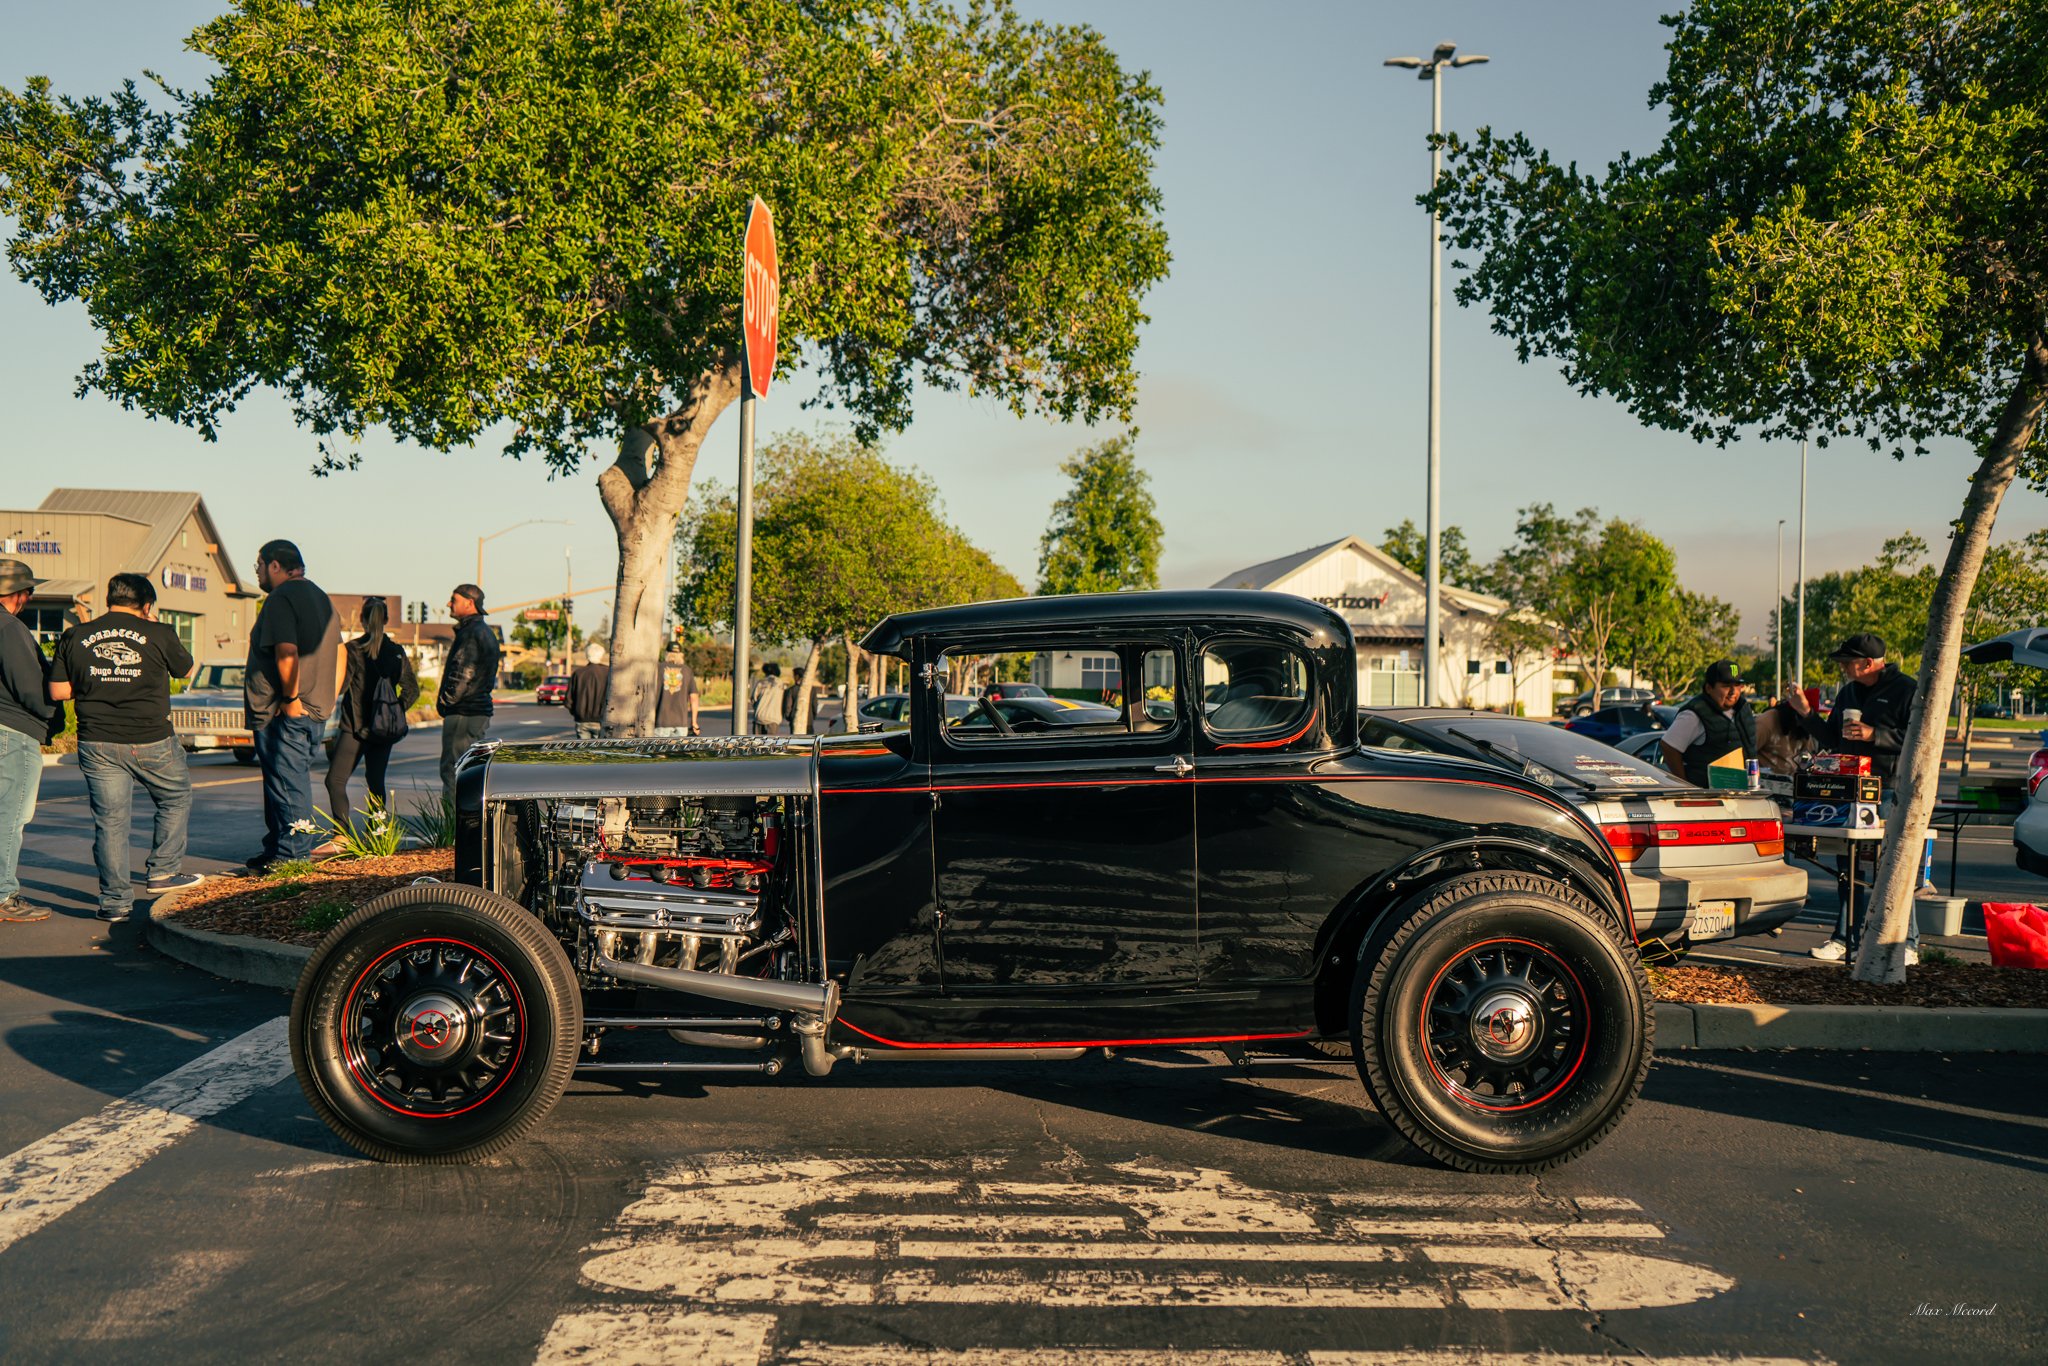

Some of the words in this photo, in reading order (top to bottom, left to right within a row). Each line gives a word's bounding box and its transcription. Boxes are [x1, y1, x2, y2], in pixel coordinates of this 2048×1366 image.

[747, 252, 777, 343] STOP
[81, 628, 147, 648] ROADSTERS
[90, 665, 112, 678] Hugo
[113, 665, 142, 678] Garage
[1685, 829, 1726, 838] 240SX
[1691, 915, 1732, 935] 2ZSZ044
